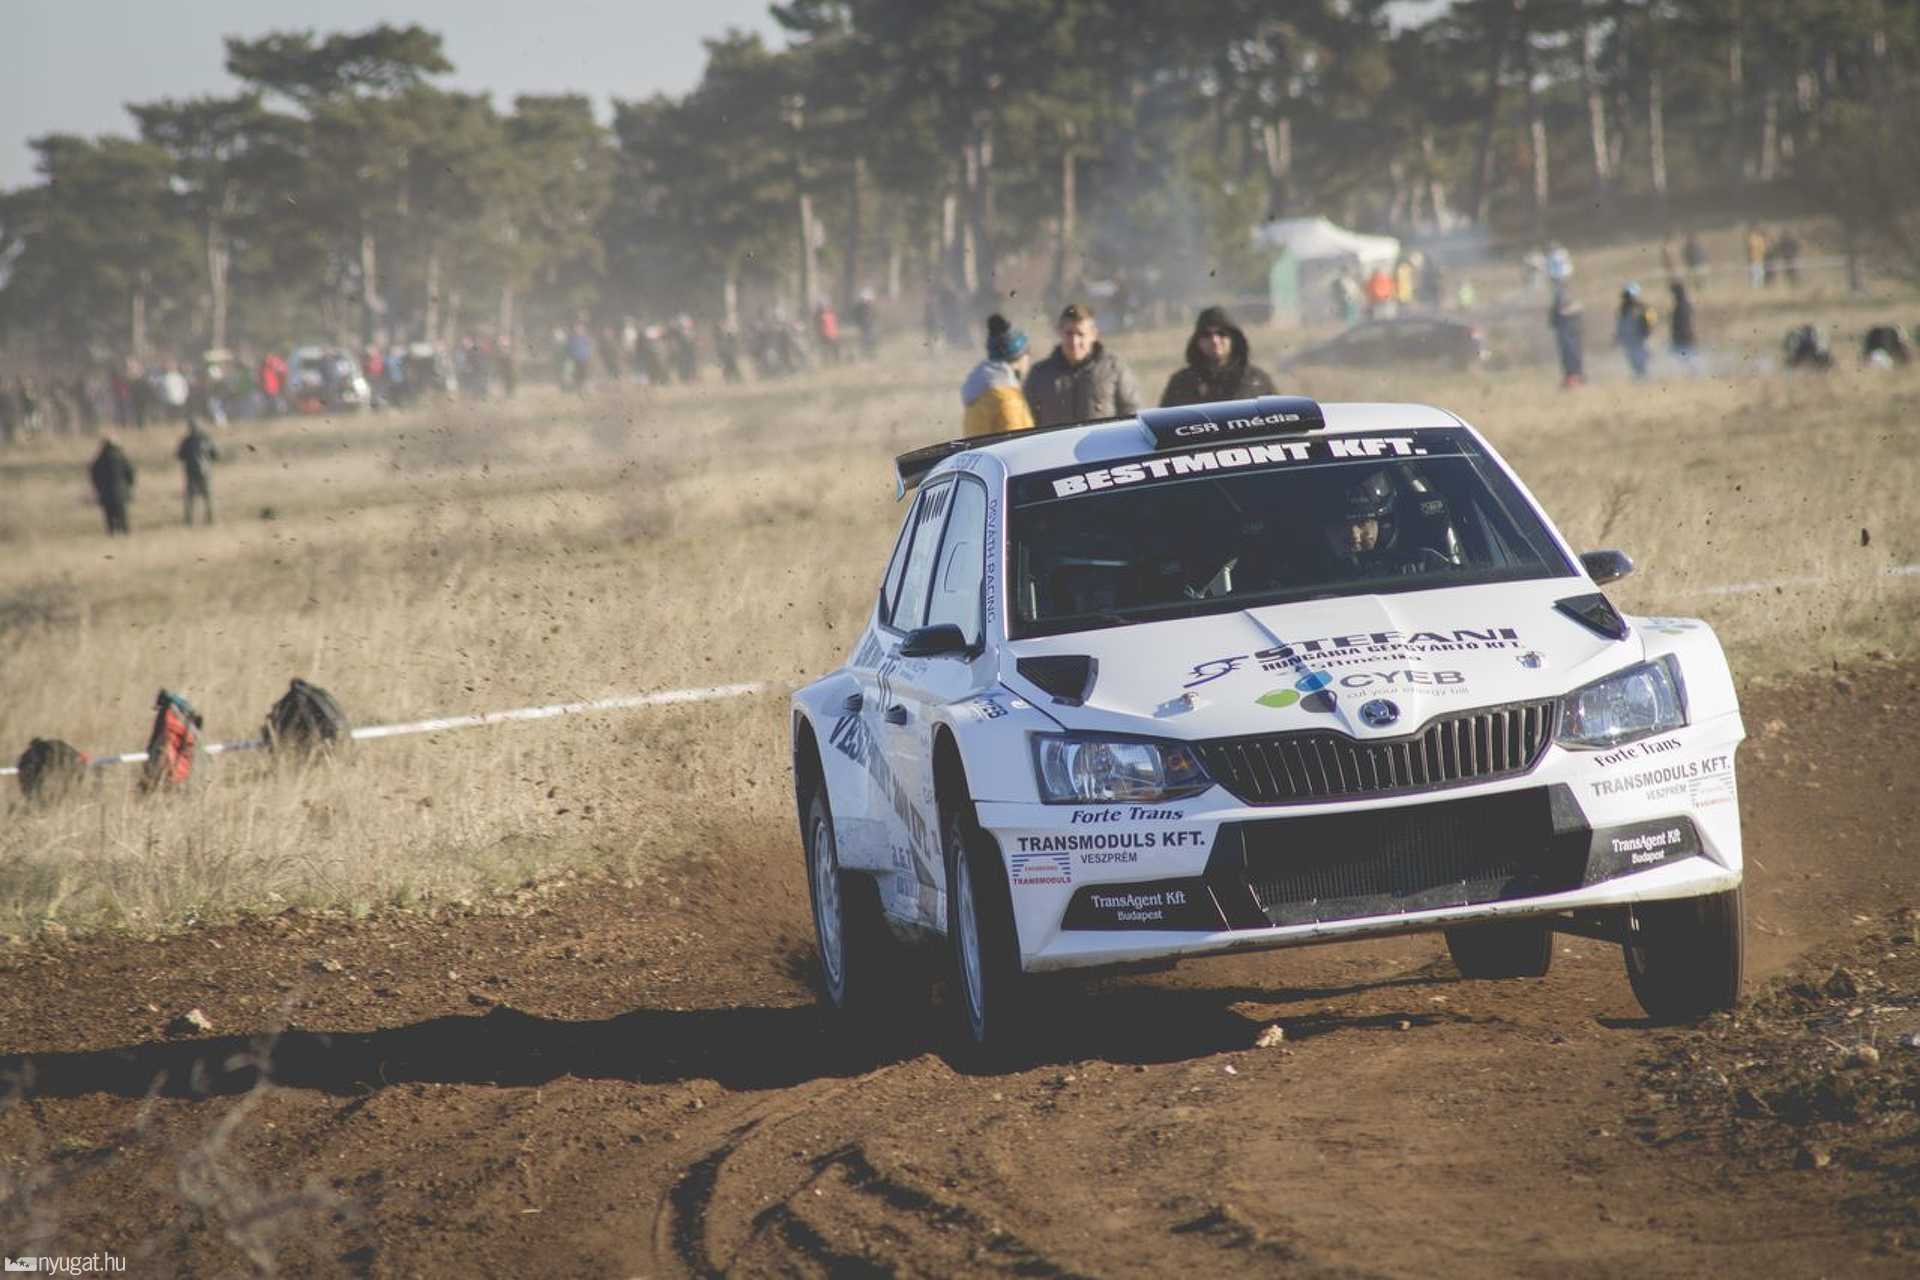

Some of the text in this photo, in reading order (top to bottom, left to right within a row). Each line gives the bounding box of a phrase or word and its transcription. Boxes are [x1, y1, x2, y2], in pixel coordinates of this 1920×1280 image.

[1175, 422, 1219, 436] CSR
[1052, 437, 1428, 498] BESTMONT KFT.
[1254, 628, 1518, 663] STEFANI
[1340, 669, 1466, 688] CYEB
[1594, 737, 1682, 768] Forte Trans
[1591, 755, 1731, 797] TRANSMODULS KFT.
[1071, 806, 1184, 824] Forte Trans
[1018, 831, 1205, 852] TRANSMODULS KFT.
[1612, 833, 1666, 852] TransAgent
[1080, 852, 1138, 864] VESZPRÉM
[1013, 876, 1072, 885] TRANSMODULS
[1090, 891, 1186, 909] TransAgent Kft
[1117, 910, 1163, 923] Budapest
